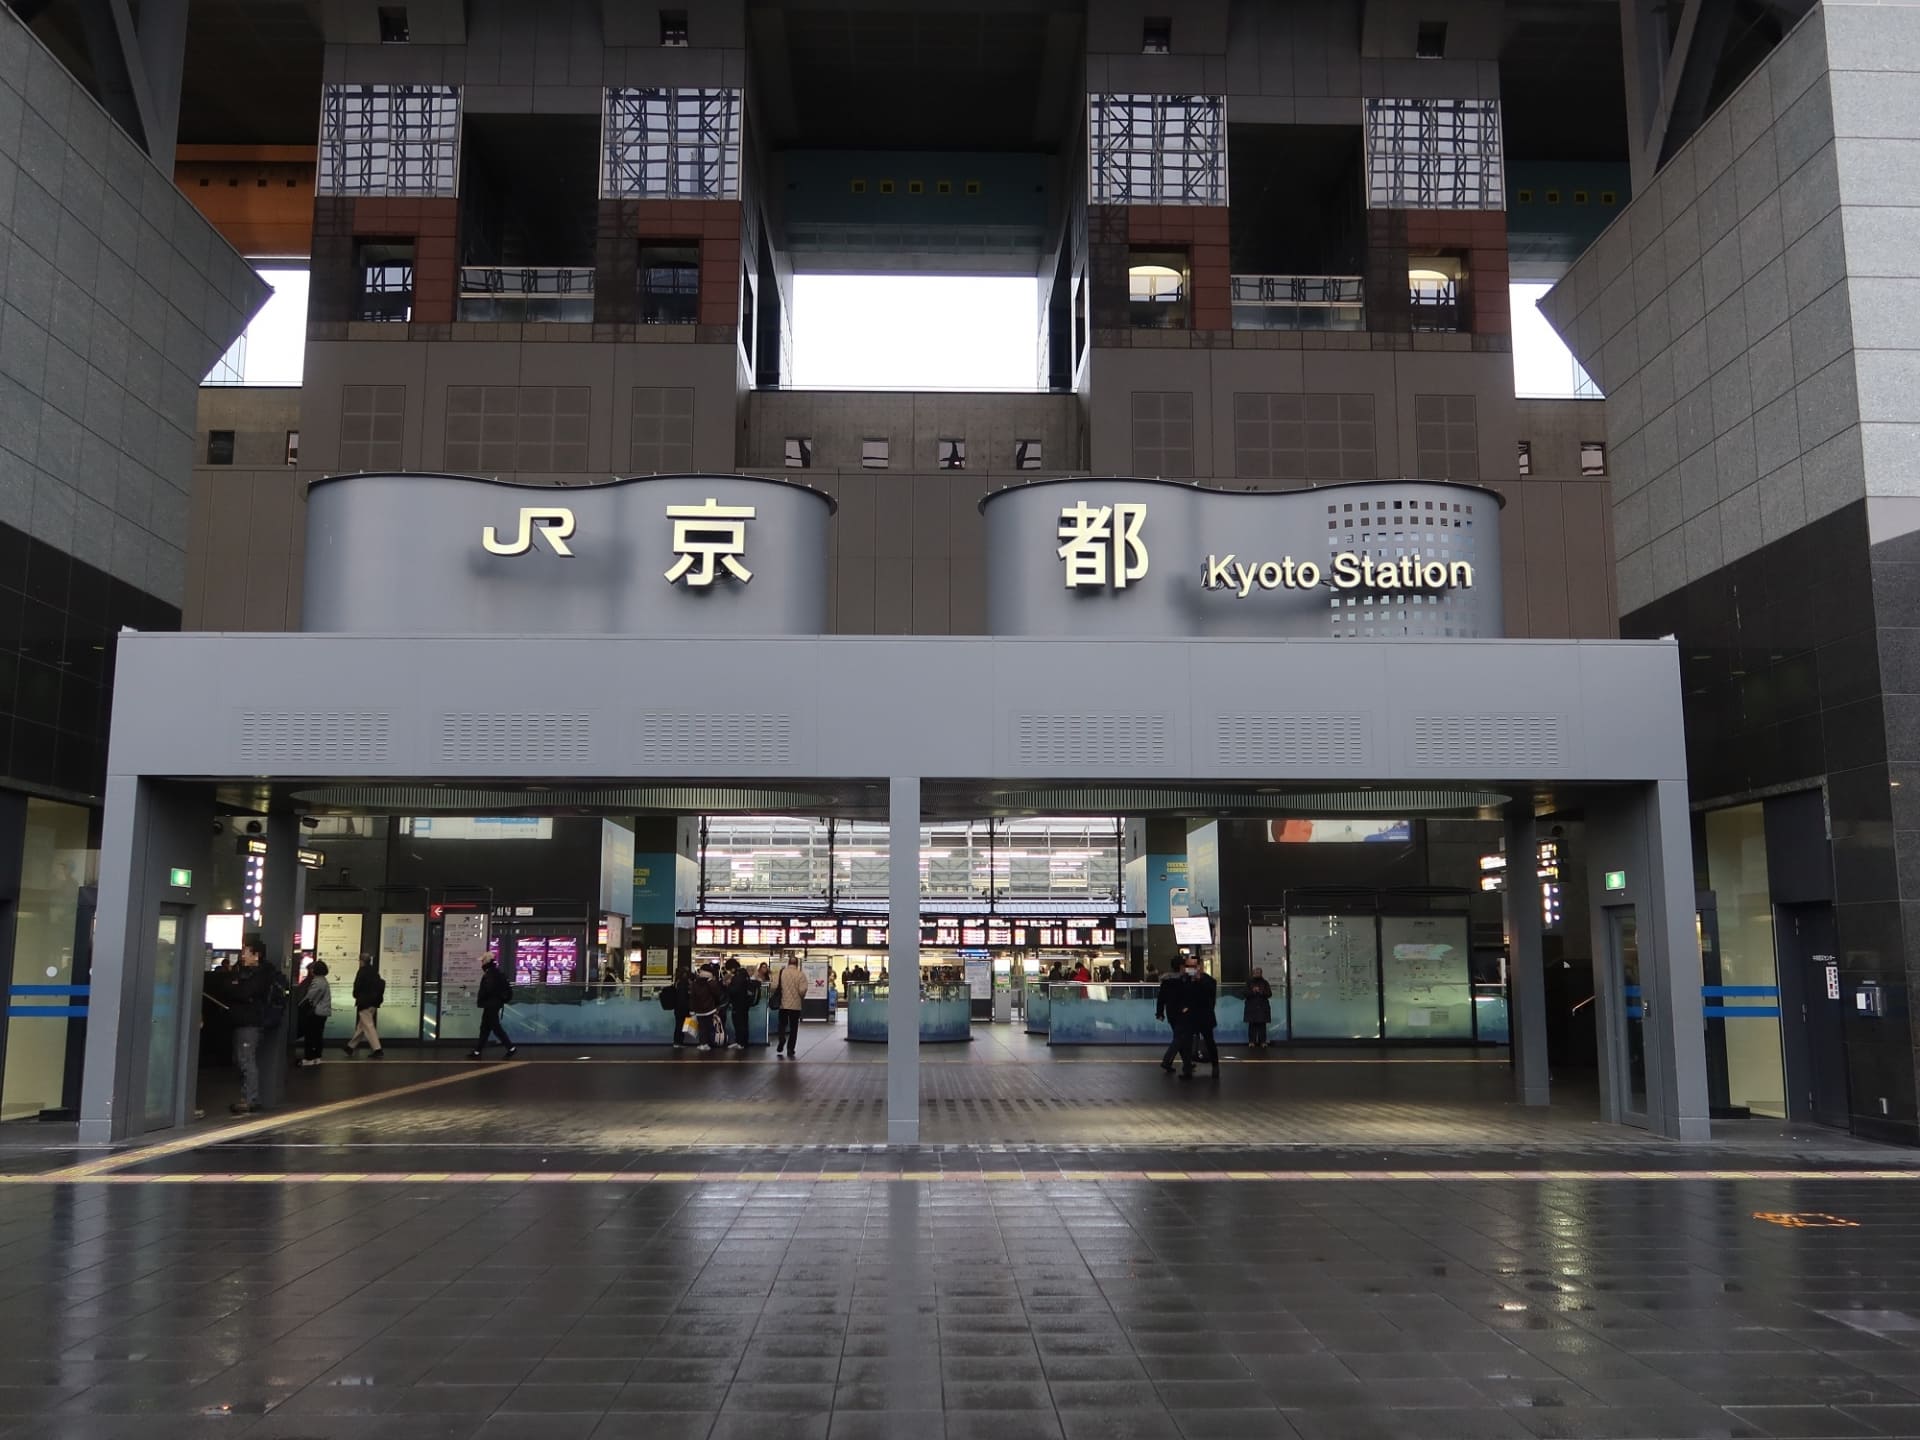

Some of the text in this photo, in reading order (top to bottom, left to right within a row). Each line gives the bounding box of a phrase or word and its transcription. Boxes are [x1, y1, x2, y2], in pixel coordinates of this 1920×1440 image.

[482, 507, 576, 556] JR
[663, 498, 756, 586] 京
[1057, 500, 1149, 589] 都
[1207, 552, 1474, 598] Kyoto Station
